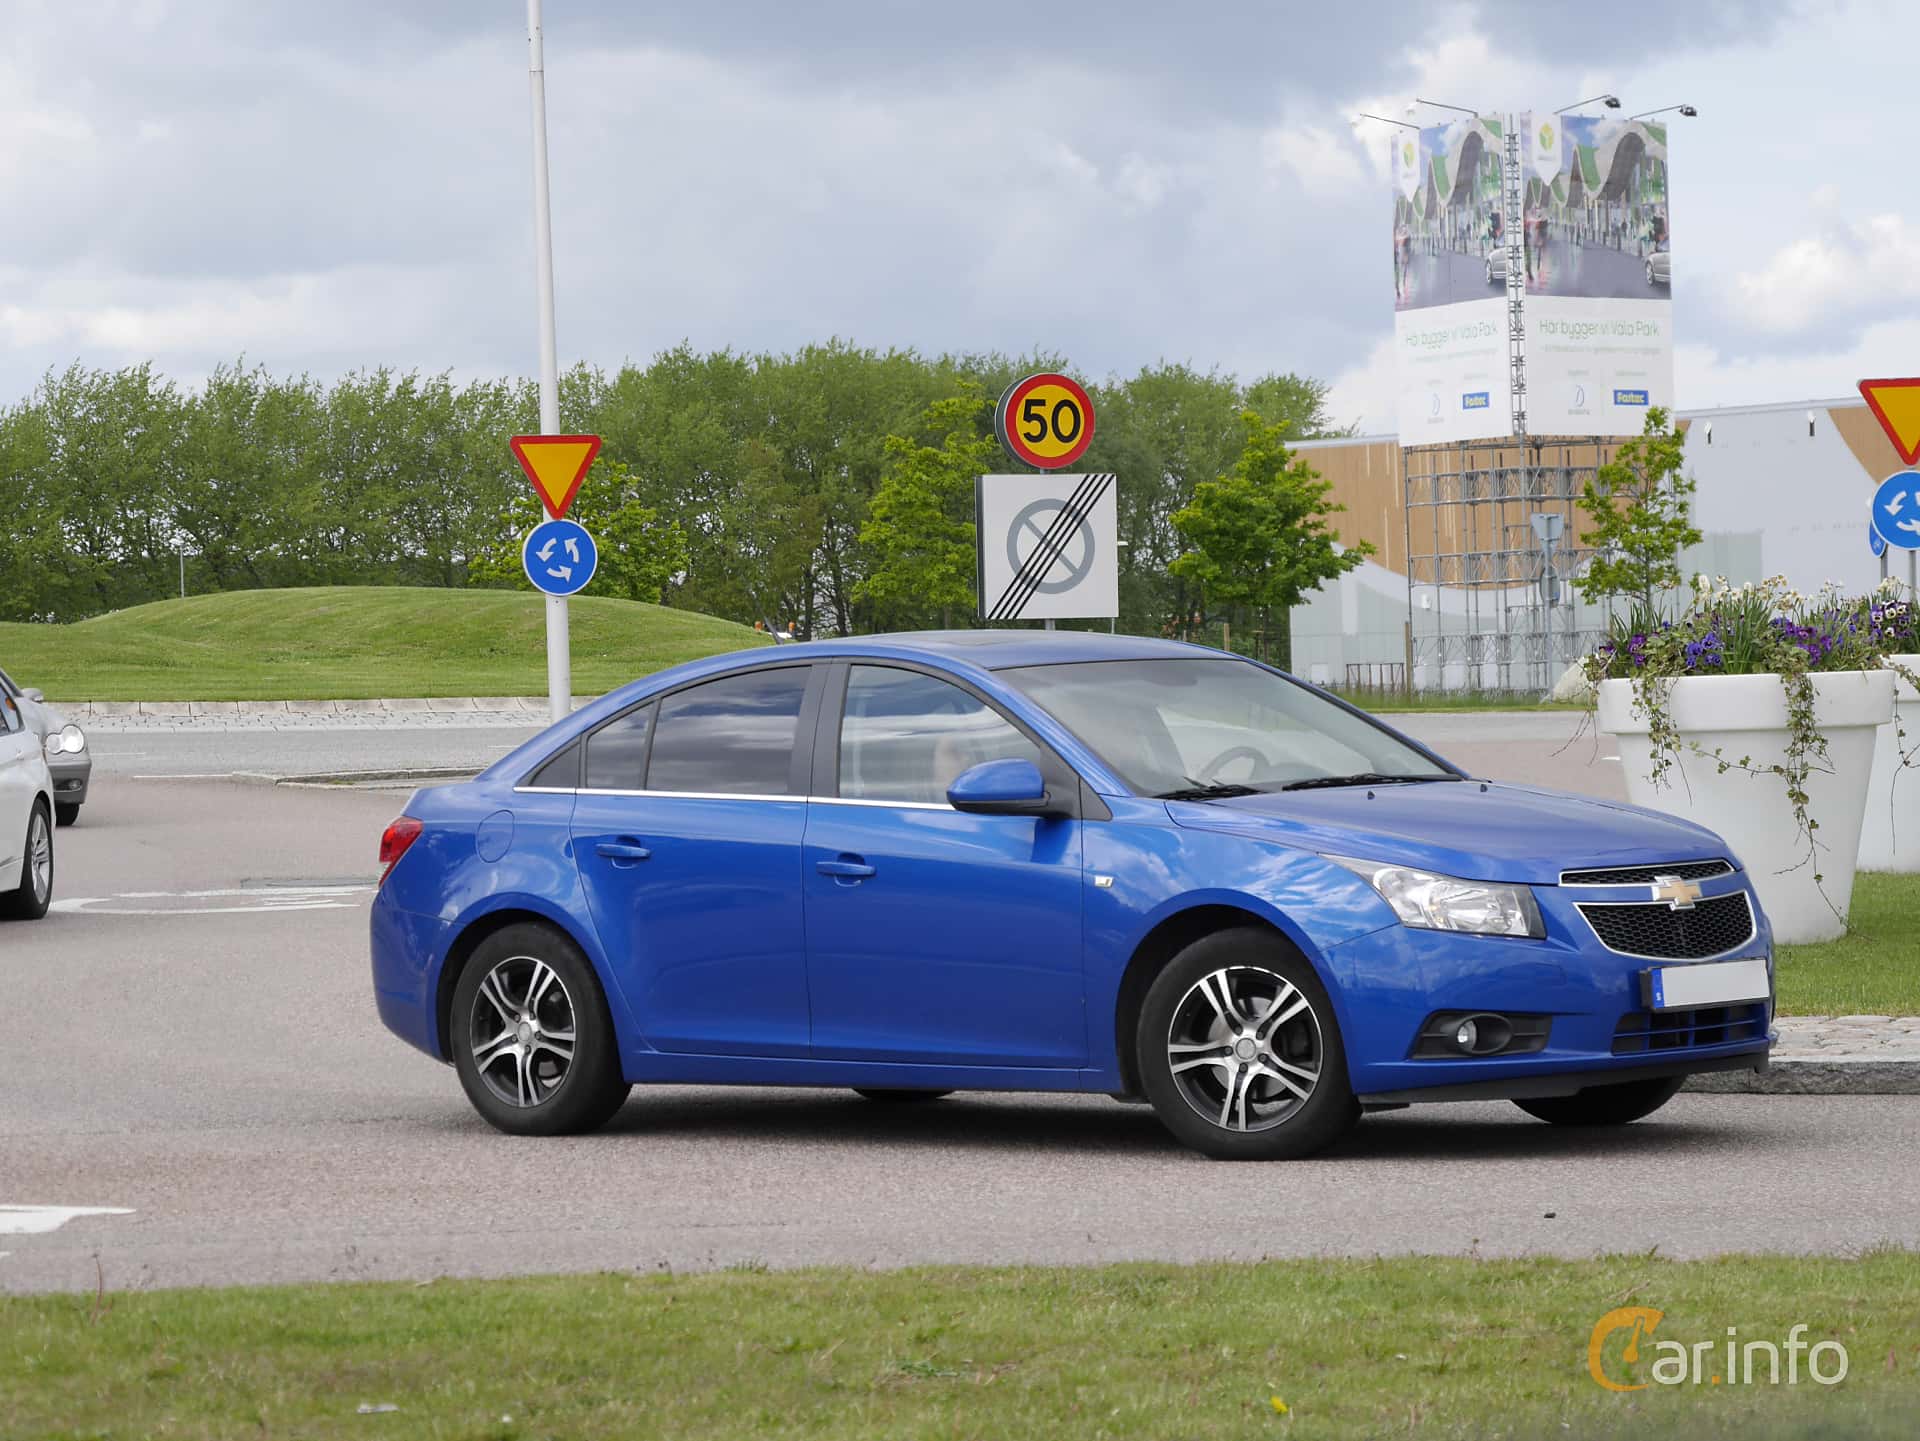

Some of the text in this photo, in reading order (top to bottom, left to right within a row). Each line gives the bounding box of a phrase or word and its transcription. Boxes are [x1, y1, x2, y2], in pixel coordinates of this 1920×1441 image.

[1561, 320, 1599, 340] bygger
[1636, 320, 1660, 336] Park
[1023, 399, 1081, 443] 50
